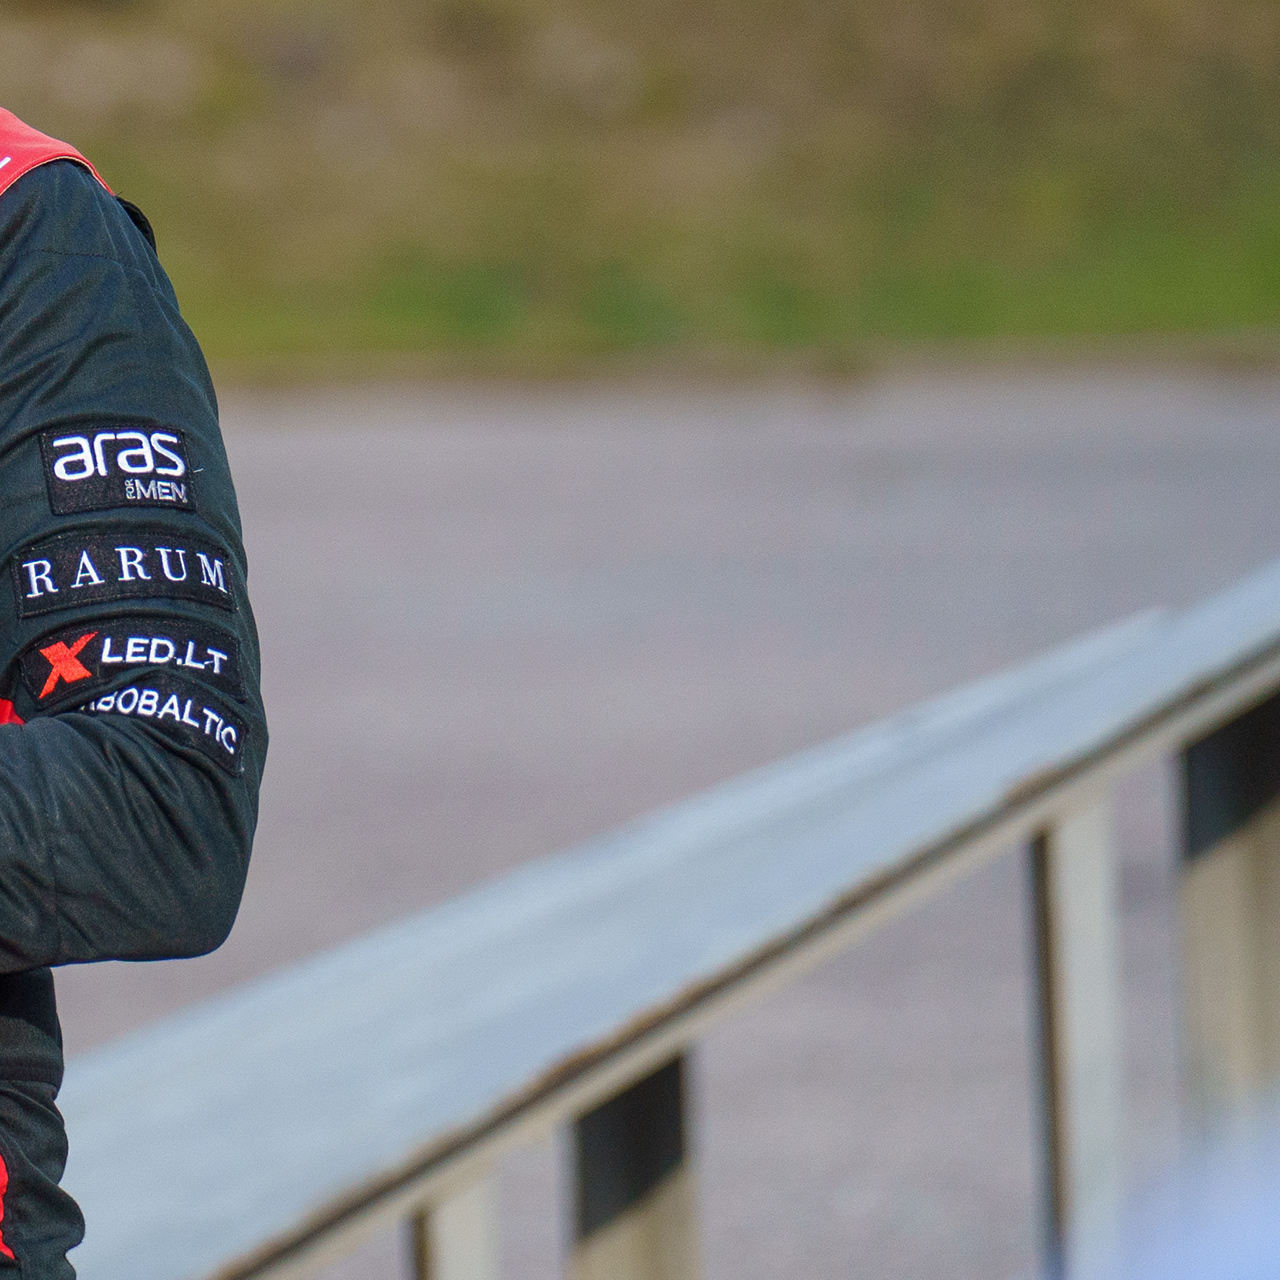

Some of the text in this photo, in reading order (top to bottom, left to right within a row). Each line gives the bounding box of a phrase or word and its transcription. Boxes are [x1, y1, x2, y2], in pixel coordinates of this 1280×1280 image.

[53, 431, 186, 481] aras
[134, 478, 188, 504] MEN
[22, 545, 230, 599] RARUM
